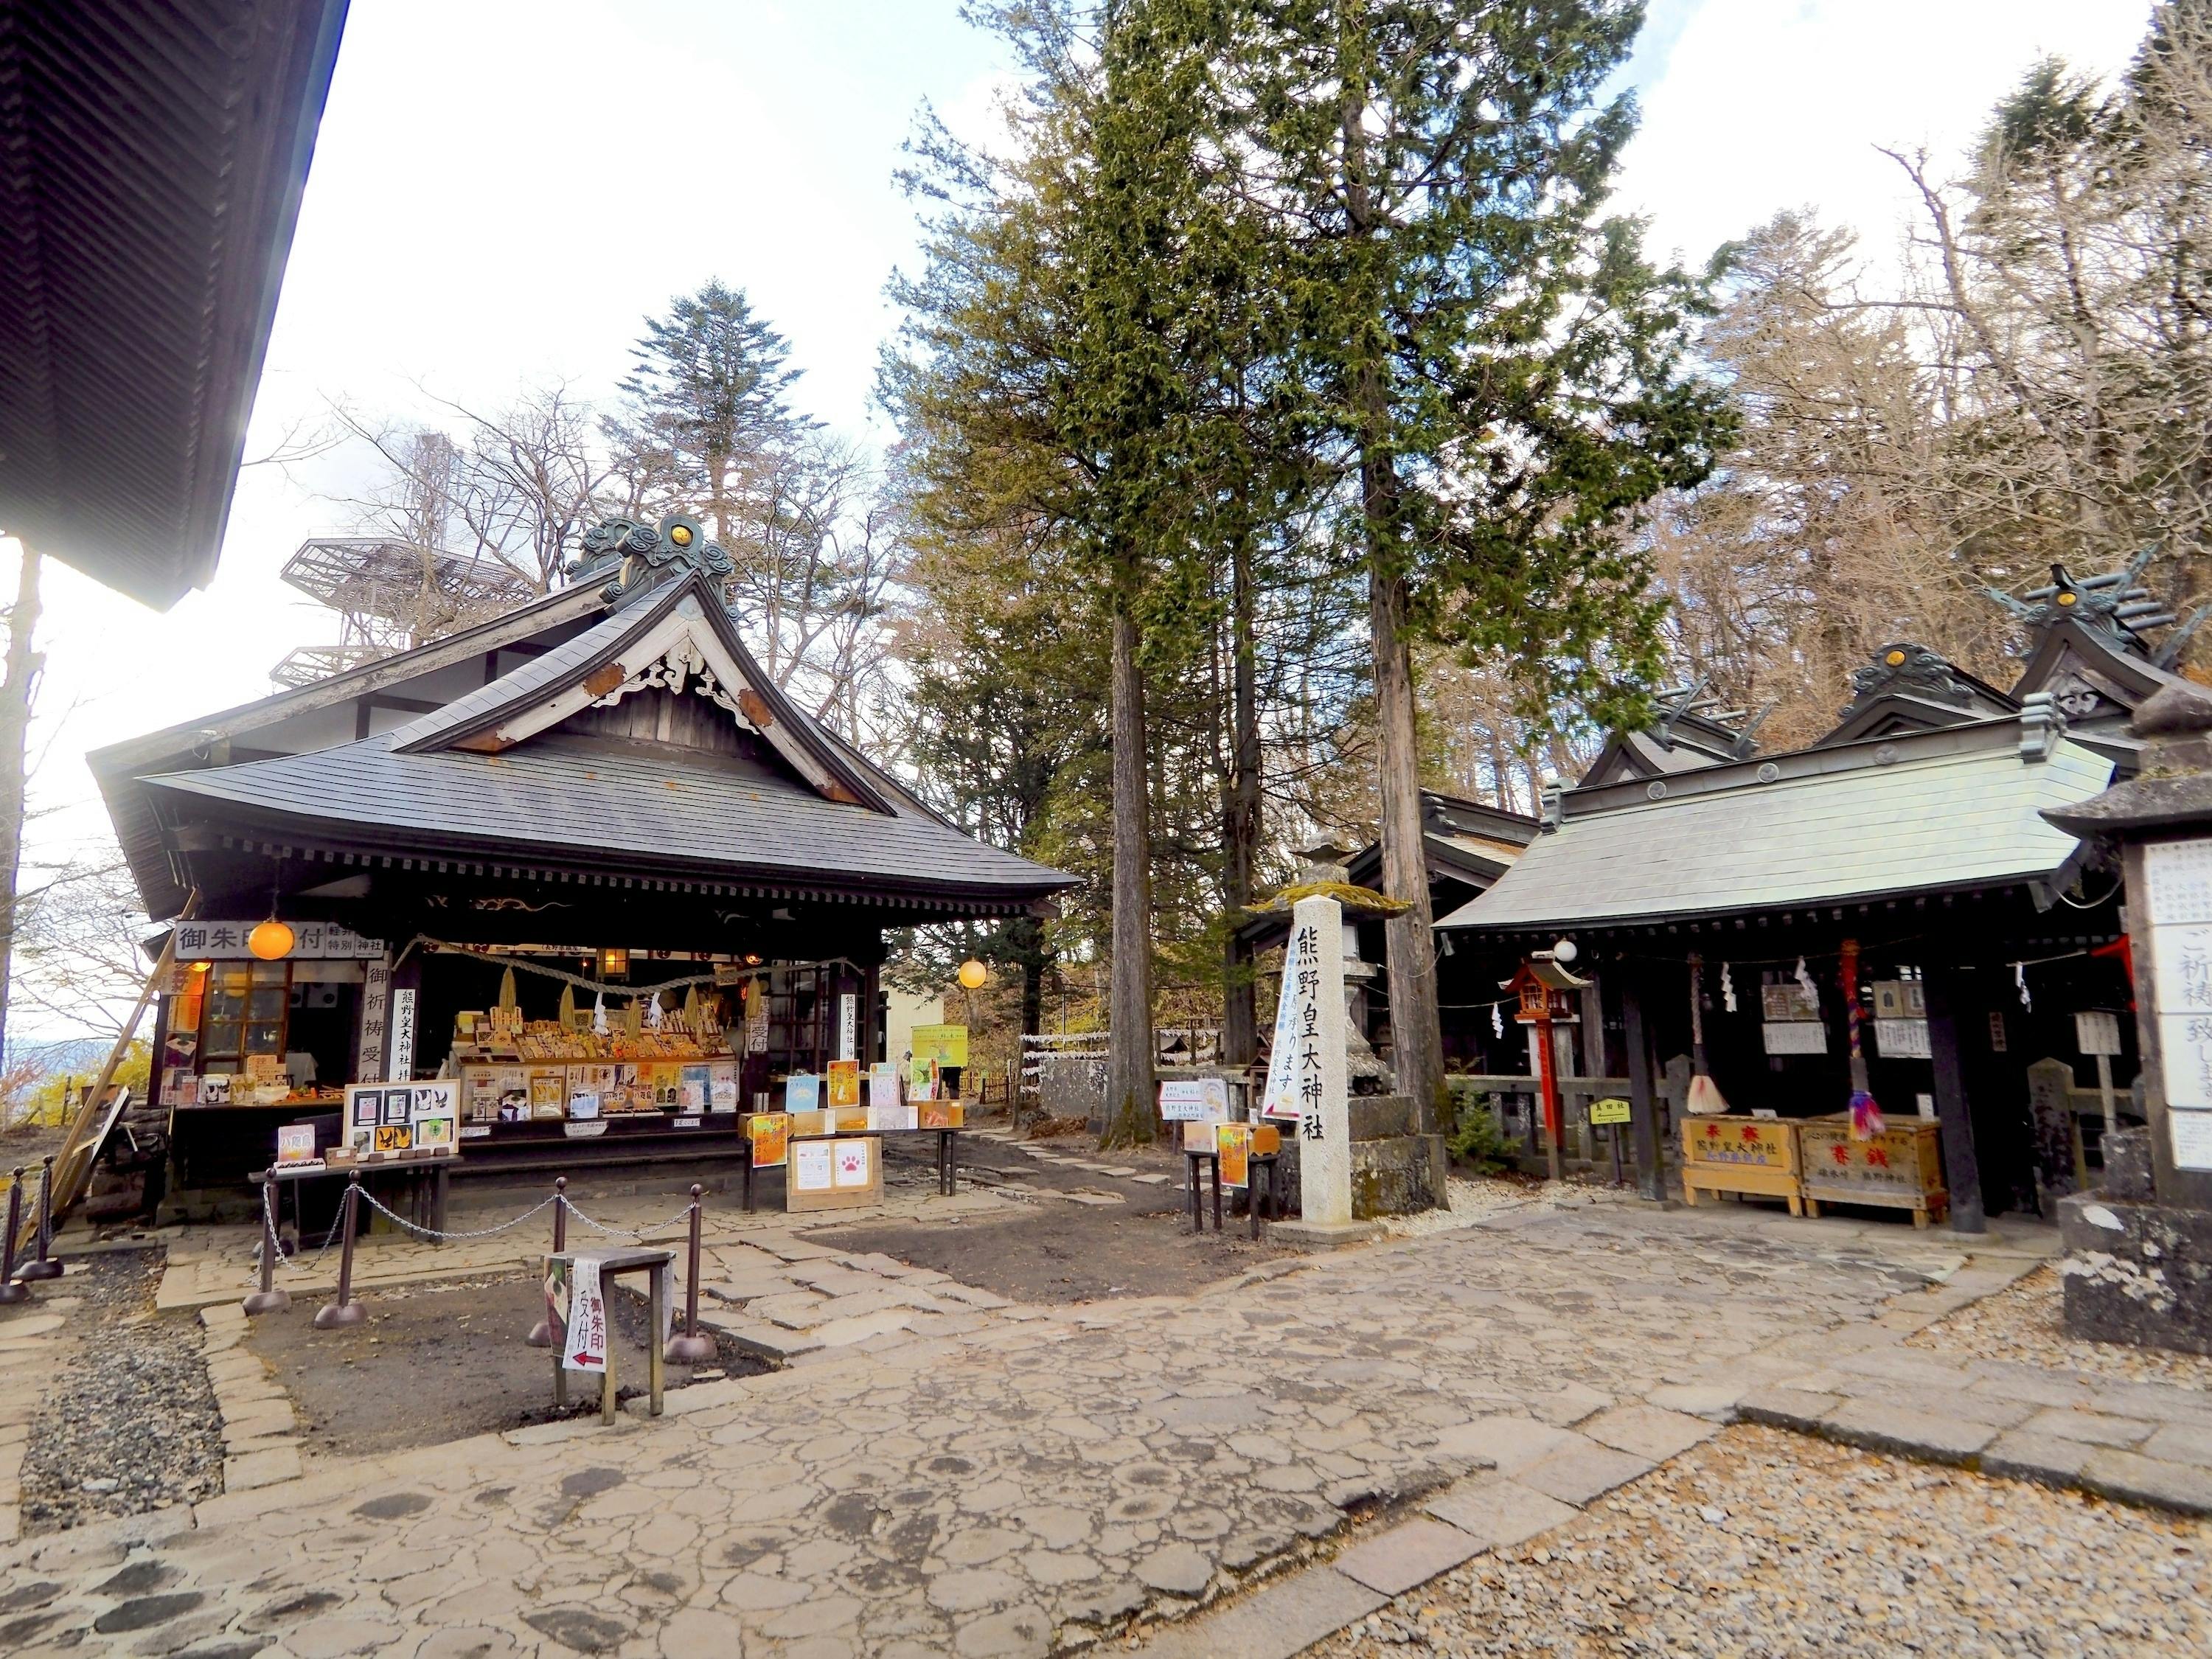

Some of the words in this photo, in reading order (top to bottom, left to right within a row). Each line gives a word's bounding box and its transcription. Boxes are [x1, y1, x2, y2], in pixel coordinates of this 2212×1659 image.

[1297, 926, 1324, 1141] 熊野皇大神社
[577, 1290, 589, 1350] 受付
[591, 1298, 604, 1352] 御朱印
